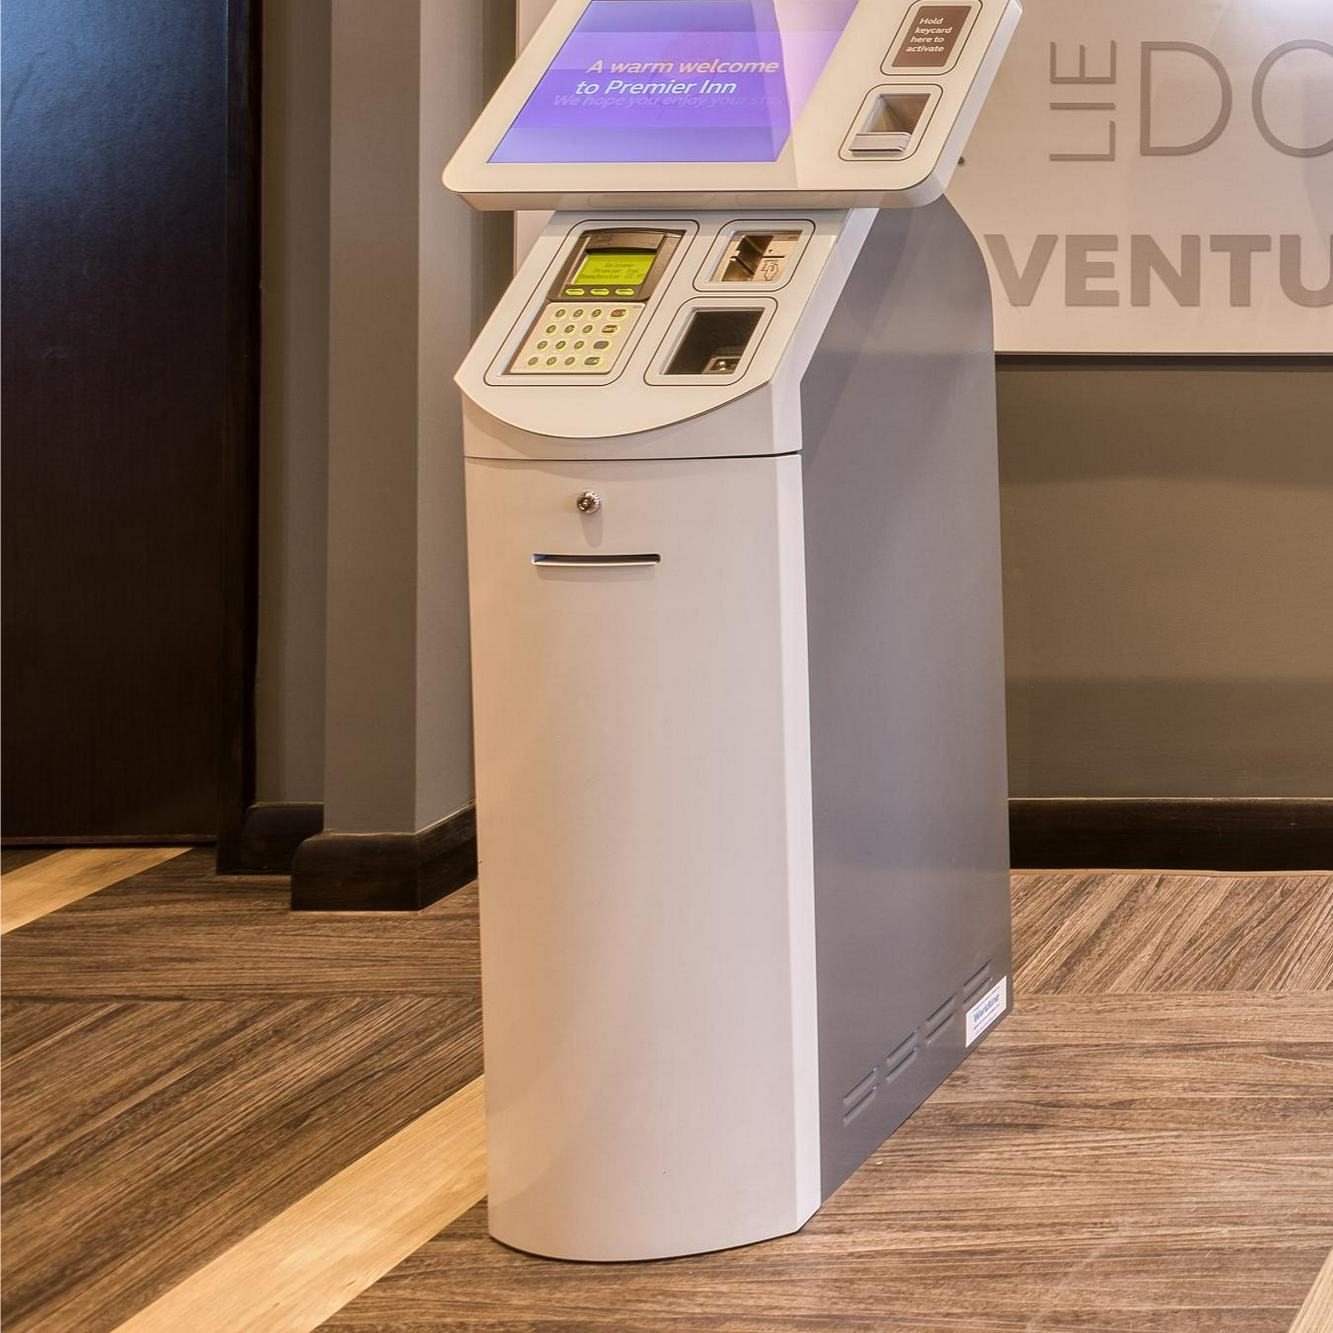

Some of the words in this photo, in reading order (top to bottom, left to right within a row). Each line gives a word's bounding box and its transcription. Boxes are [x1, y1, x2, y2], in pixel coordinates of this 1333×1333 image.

[919, 17, 944, 25] Hold
[914, 27, 953, 35] keycard
[585, 59, 604, 74] A
[610, 61, 674, 74] warm
[678, 58, 779, 74] welcome
[575, 80, 600, 95] to
[604, 78, 697, 94] Premier
[700, 78, 737, 94] Inn
[1049, 40, 1117, 162] LIE
